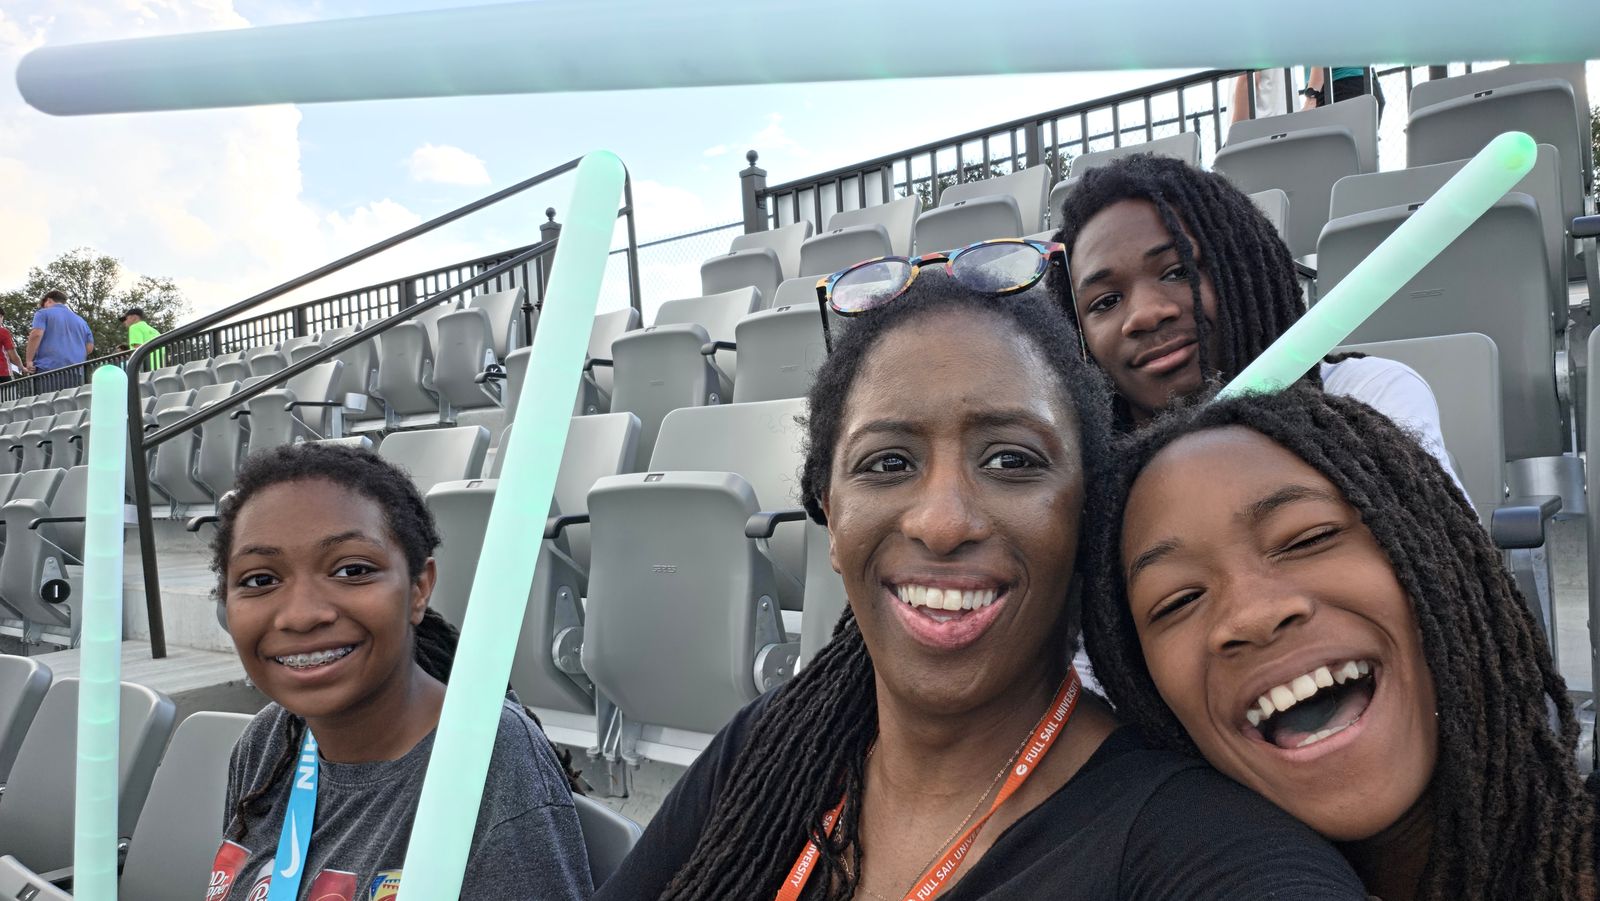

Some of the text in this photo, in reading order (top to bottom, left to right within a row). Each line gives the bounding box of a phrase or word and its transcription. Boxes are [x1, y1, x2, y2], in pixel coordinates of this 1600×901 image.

[297, 731, 317, 790] NIK
[1025, 742, 1045, 763] FULL
[1040, 721, 1058, 742] SAIL
[209, 871, 229, 886] Dr
[791, 842, 817, 887] IVERSITY
[916, 878, 938, 900] FULL
[936, 861, 955, 880] SAIL
